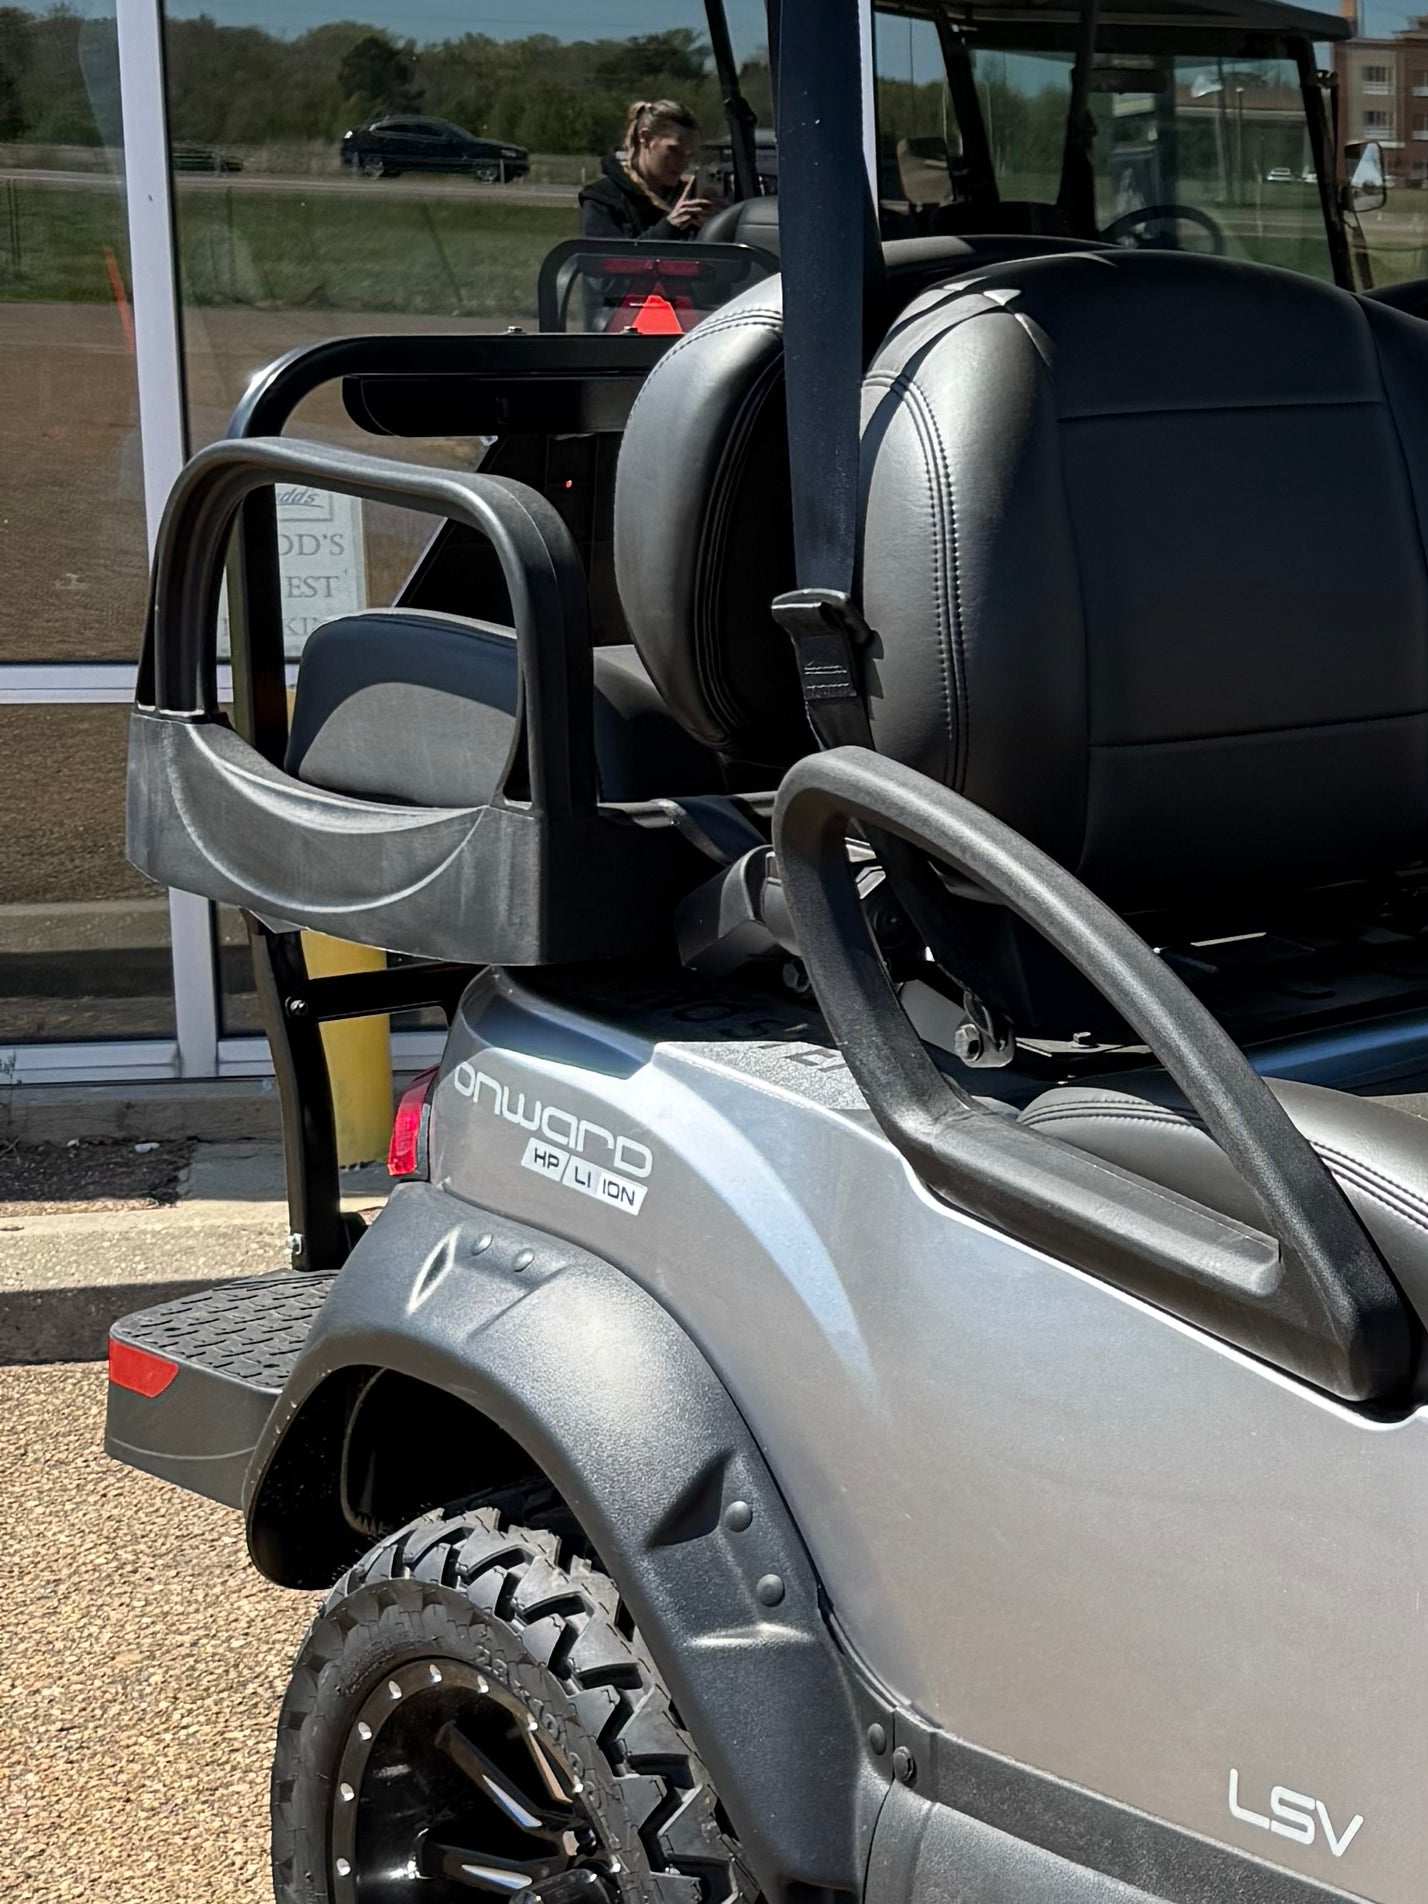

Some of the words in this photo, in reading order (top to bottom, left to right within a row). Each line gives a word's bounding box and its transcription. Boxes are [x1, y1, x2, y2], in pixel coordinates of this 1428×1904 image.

[533, 1147, 560, 1170] HP
[574, 1166, 592, 1189] LI
[602, 1178, 636, 1207] ION
[1227, 1767, 1364, 1859] LSV
